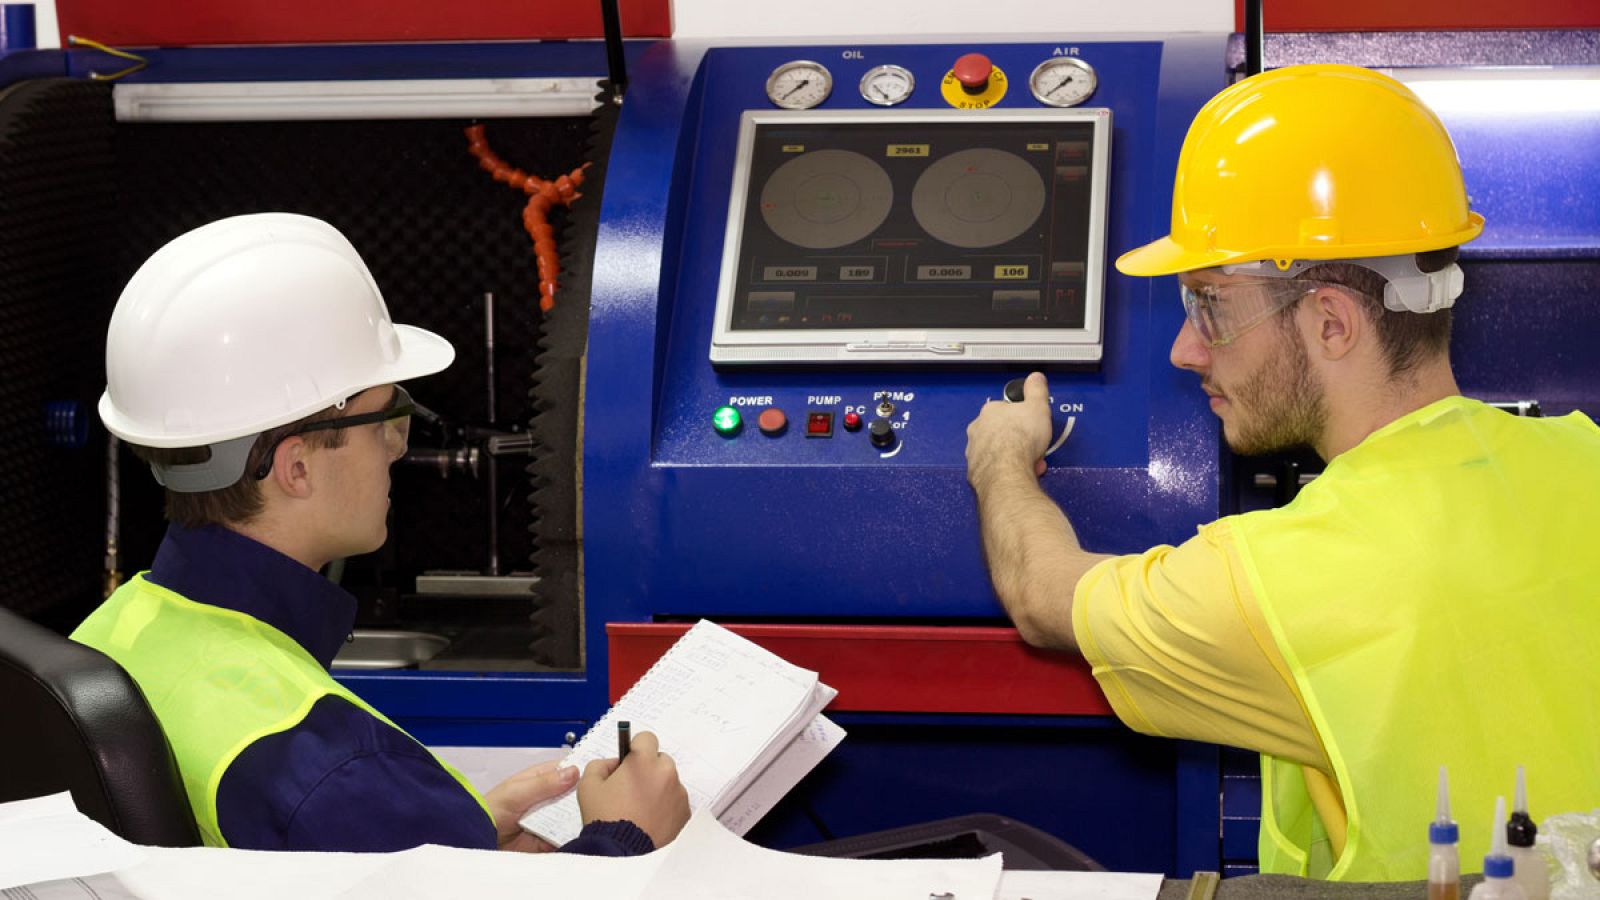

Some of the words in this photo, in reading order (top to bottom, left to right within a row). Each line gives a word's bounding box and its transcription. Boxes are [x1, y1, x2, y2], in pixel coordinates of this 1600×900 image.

[842, 50, 864, 59] OIL
[1053, 47, 1080, 56] AIR
[959, 99, 991, 109] STOP
[1002, 267, 1025, 276] 106
[729, 395, 773, 406] POWER
[807, 395, 841, 405] PUMP
[1060, 403, 1083, 412] ON
